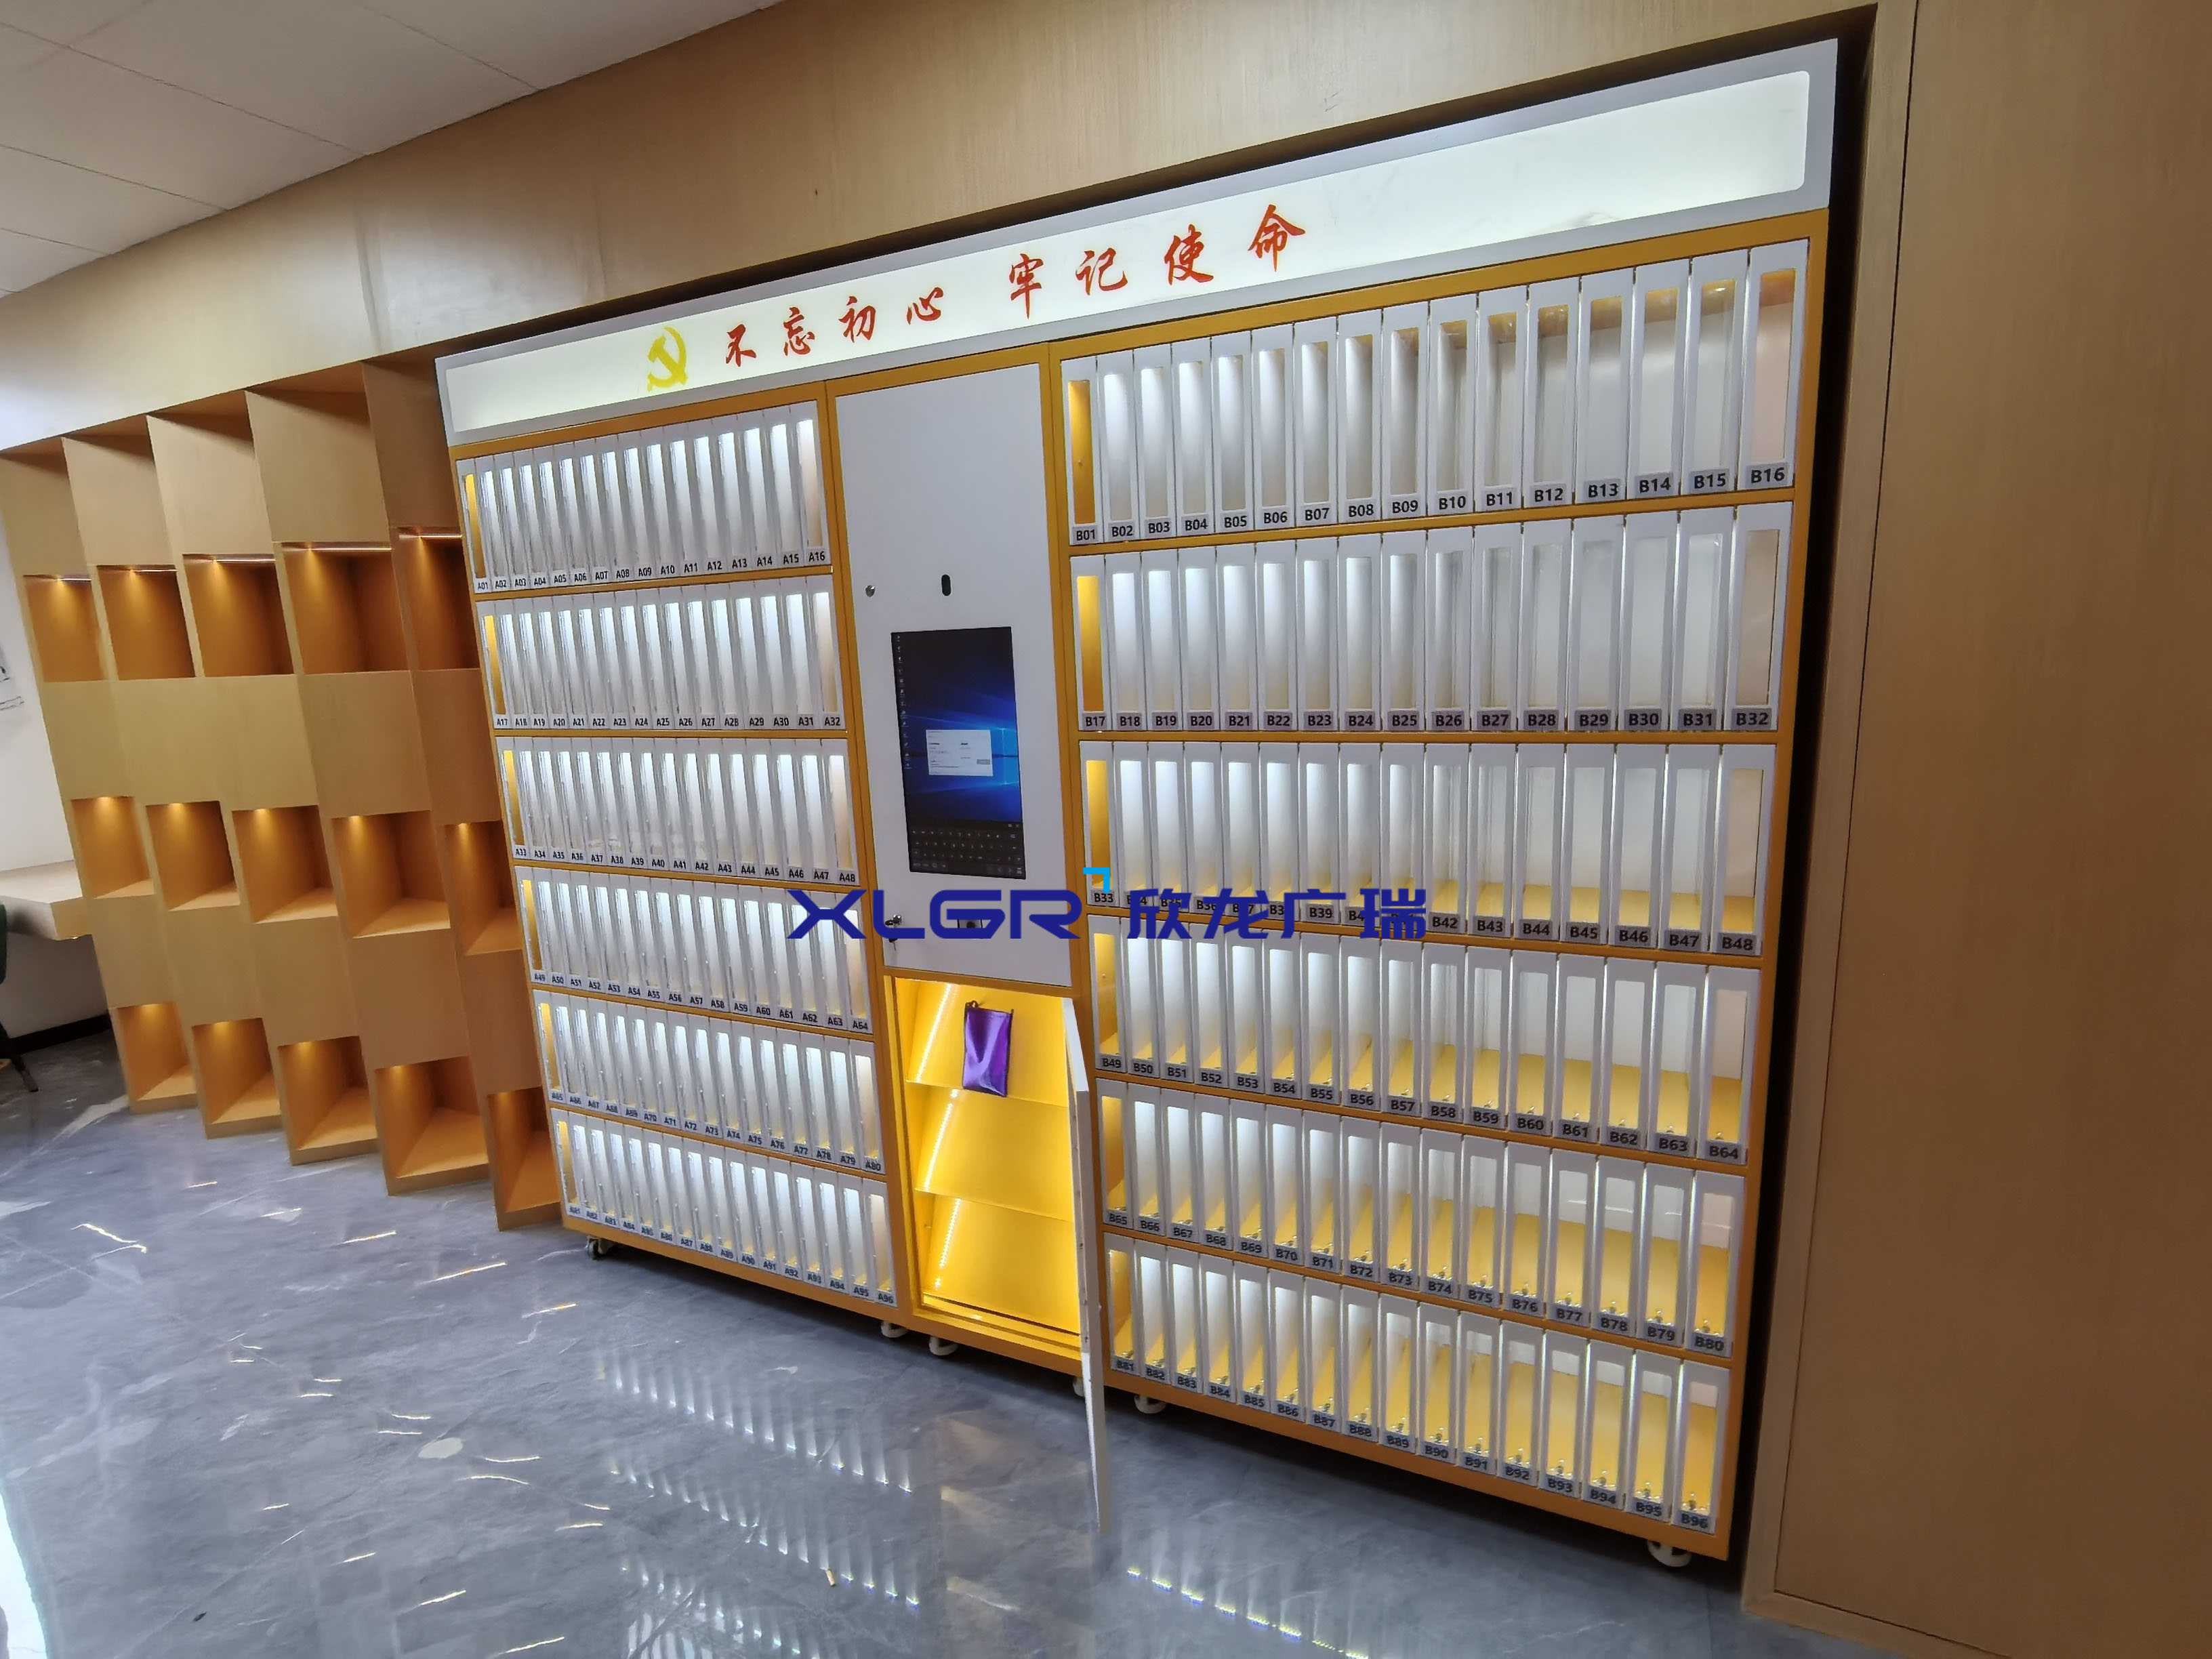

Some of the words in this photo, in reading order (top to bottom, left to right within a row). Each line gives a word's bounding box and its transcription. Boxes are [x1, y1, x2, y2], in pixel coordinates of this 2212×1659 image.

[725, 286, 944, 367] 不忘初心
[1008, 204, 1306, 319] 牢记使命
[1694, 474, 1726, 488] B15
[1750, 468, 1785, 483] B16
[1588, 483, 1618, 497] B13
[1639, 478, 1671, 493] B14
[1486, 493, 1513, 506] B11
[1534, 488, 1563, 502] B12
[1392, 500, 1418, 514] B09
[1439, 496, 1467, 510] B10
[1305, 508, 1330, 520] B07
[1349, 504, 1374, 518] B08
[1185, 518, 1208, 531] B04
[1224, 515, 1247, 528] B05
[1263, 512, 1288, 525] B06
[1111, 525, 1133, 537] B02
[1148, 522, 1170, 533] B03
[1076, 530, 1095, 541] B01
[757, 556, 772, 567] A14
[783, 554, 798, 564] A15
[808, 551, 825, 562] A16
[684, 563, 697, 573] A11
[708, 561, 722, 570] A12
[732, 558, 747, 568] A13
[595, 571, 609, 579] A07
[616, 569, 629, 578] A08
[638, 567, 652, 578] A09
[660, 565, 674, 574] A10
[554, 575, 567, 583] A05
[575, 573, 586, 581] A06
[679, 718, 693, 726] A26
[701, 718, 715, 726] A27
[724, 718, 739, 726] A28
[750, 718, 764, 726] A29
[773, 718, 789, 726] A30
[798, 718, 813, 726] A31
[824, 718, 840, 726] A32
[1086, 716, 1105, 727] B17
[1120, 716, 1141, 727] B18
[1155, 716, 1176, 726] B19
[1190, 716, 1212, 726] B20
[1229, 716, 1250, 726] B21
[1267, 715, 1290, 726] B22
[1308, 715, 1332, 726] B23
[1349, 715, 1373, 726] B24
[1392, 714, 1417, 726] B25
[1435, 714, 1462, 726] B26
[1481, 714, 1509, 726] B27
[1528, 714, 1556, 726] B28
[1580, 714, 1608, 726] B29
[1629, 714, 1659, 726] B30
[1683, 714, 1712, 726] B31
[1736, 713, 1768, 725] B32
[765, 867, 779, 876] A45
[789, 869, 804, 878] A46
[814, 871, 829, 880] A47
[840, 873, 855, 882] A48
[1094, 893, 1113, 903] B33
[1309, 907, 1332, 918] B39
[1433, 917, 1458, 929] B42
[1477, 920, 1502, 932] B43
[1523, 923, 1549, 935] B44
[1570, 927, 1597, 939] B45
[1619, 930, 1648, 943] B46
[1669, 934, 1698, 947] B47
[1722, 937, 1753, 950] B48
[779, 1009, 793, 1019] A61
[828, 1017, 842, 1026] A63
[1103, 1057, 1121, 1069] B49
[1134, 1062, 1153, 1073] B50
[1168, 1067, 1186, 1078] B51
[1201, 1071, 1222, 1084] B52
[1237, 1076, 1258, 1088] B53
[1274, 1082, 1295, 1094] B54
[1311, 1088, 1333, 1099] B55
[1351, 1093, 1374, 1105] B56
[1391, 1100, 1414, 1111] B57
[1431, 1105, 1456, 1118] B58
[1473, 1111, 1498, 1124] B59
[1517, 1117, 1544, 1130] B60
[1563, 1124, 1589, 1137] B61
[1610, 1131, 1637, 1145] B62
[1659, 1137, 1687, 1152] B63
[1709, 1145, 1738, 1159] B64
